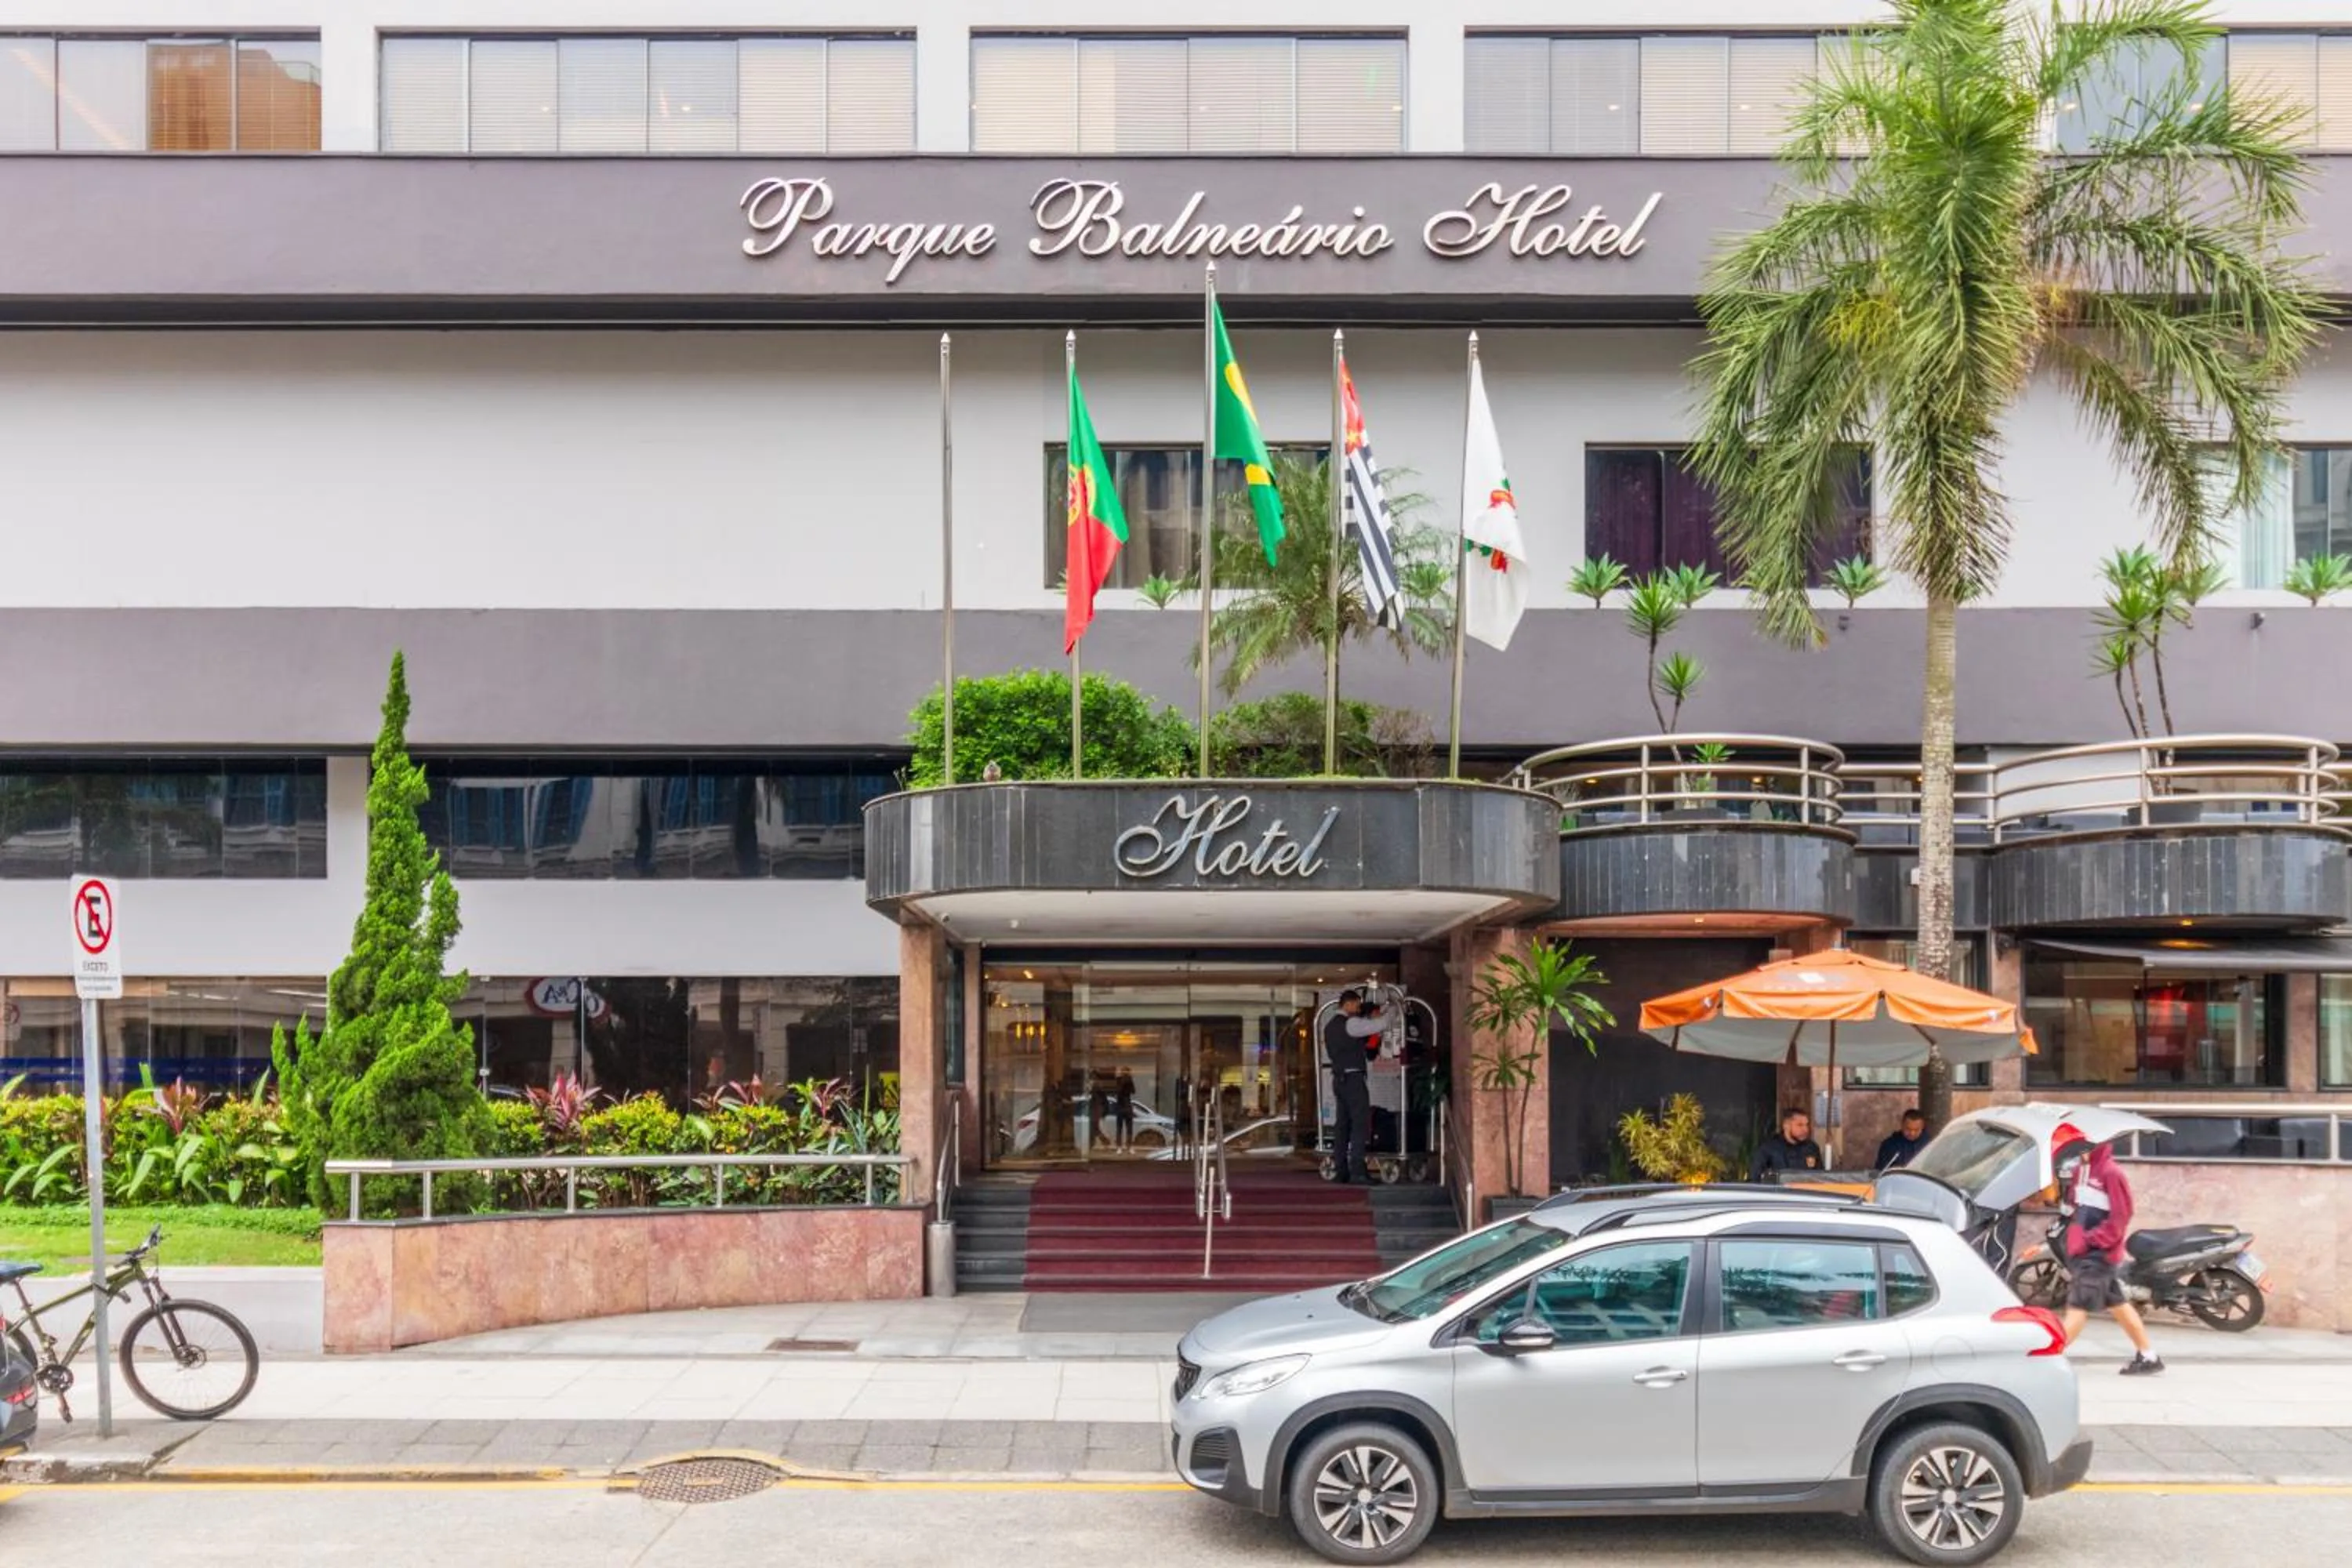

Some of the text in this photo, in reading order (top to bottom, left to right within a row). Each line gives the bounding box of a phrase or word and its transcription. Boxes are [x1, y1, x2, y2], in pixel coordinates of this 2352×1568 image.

[740, 177, 1663, 283] Parque Balneário Hotel
[1114, 793, 1341, 877] Hotel
